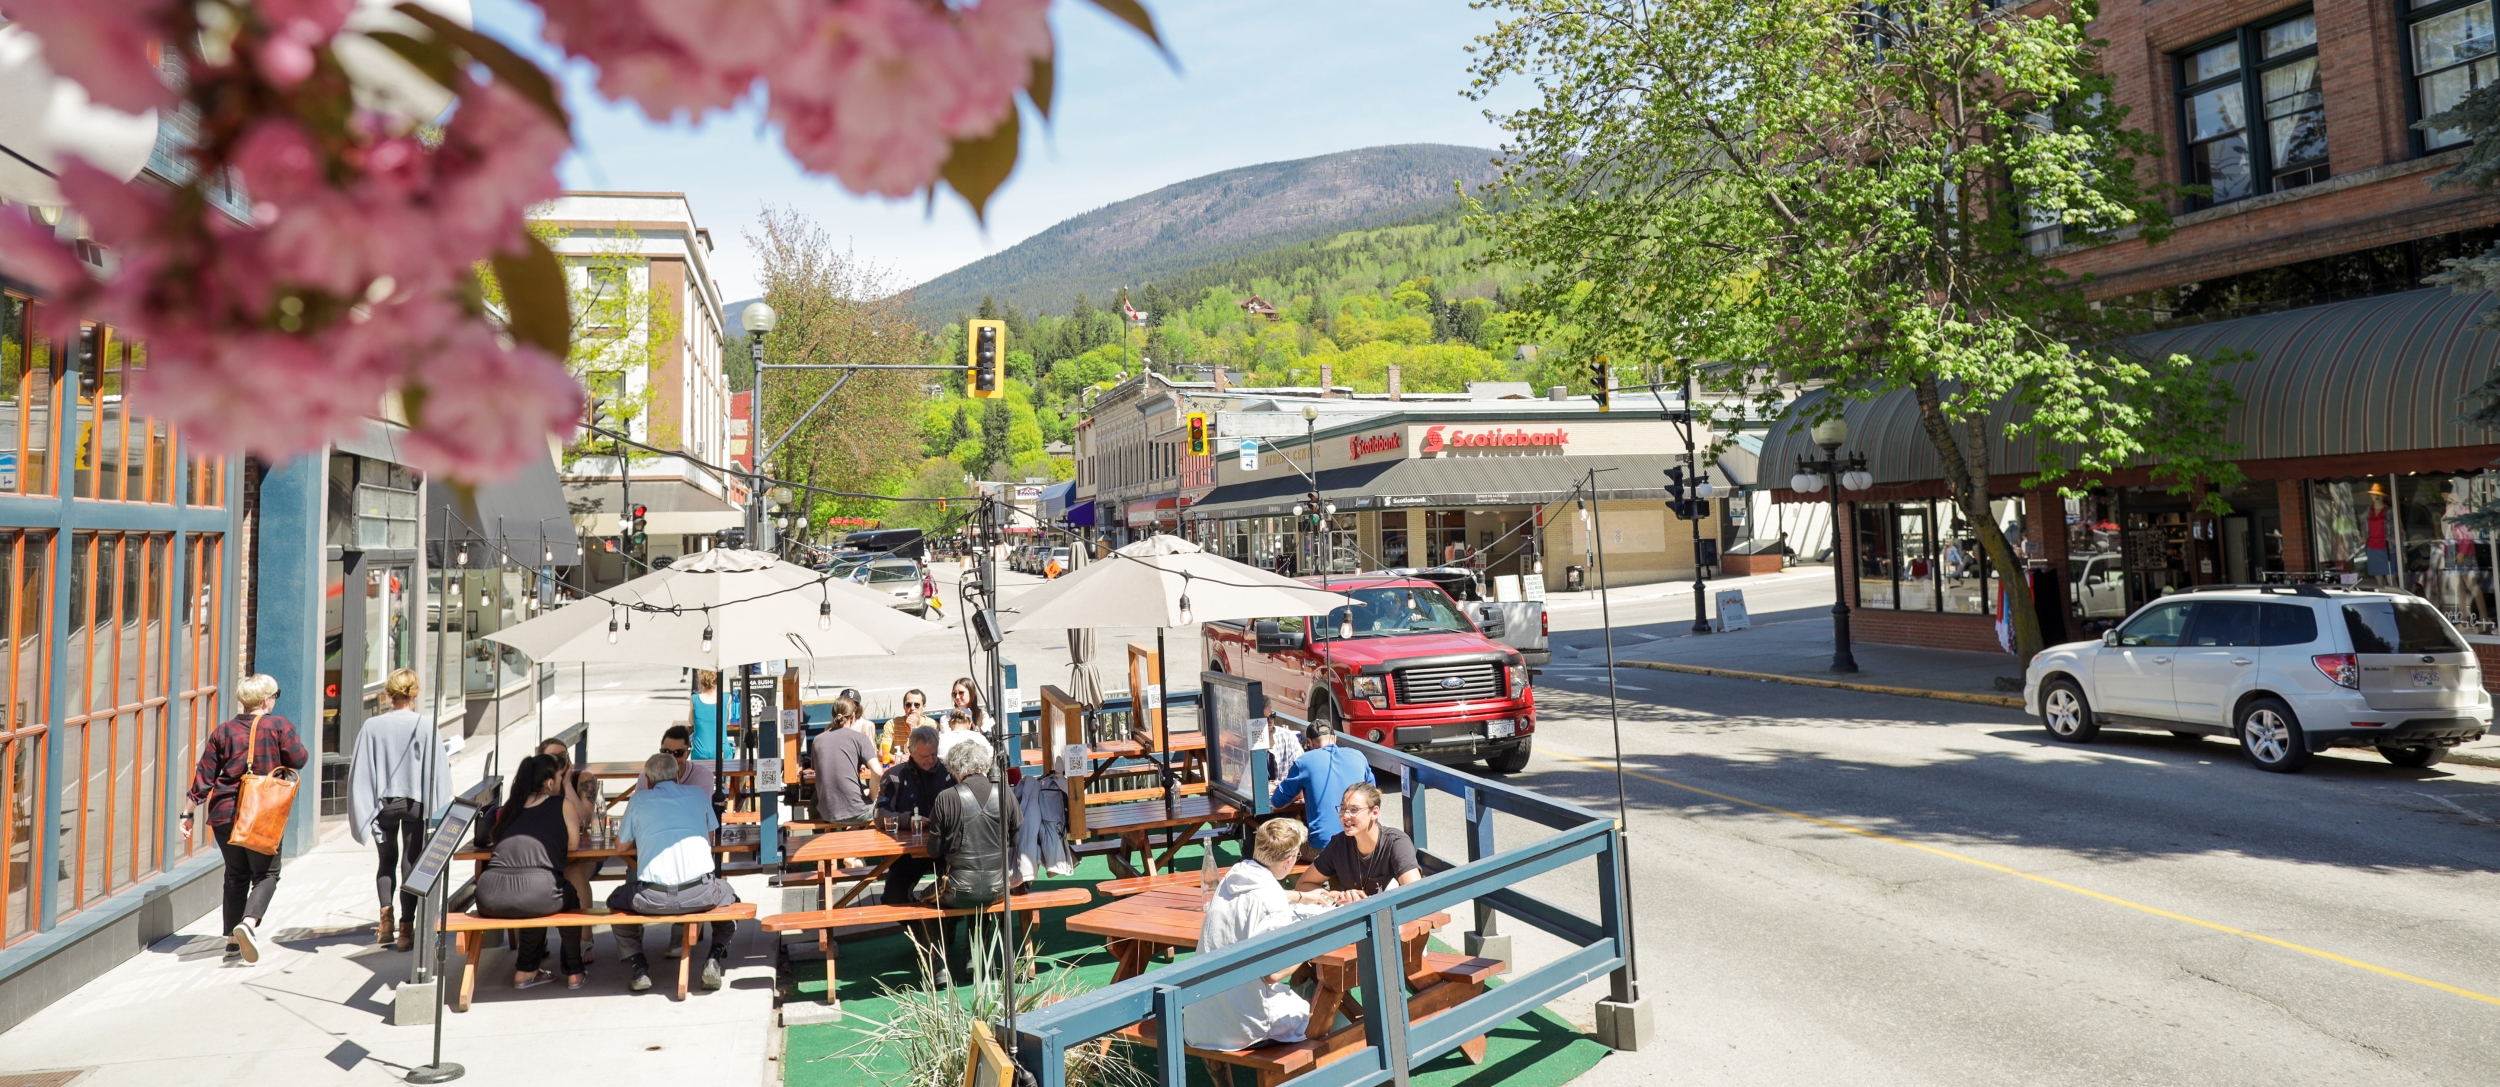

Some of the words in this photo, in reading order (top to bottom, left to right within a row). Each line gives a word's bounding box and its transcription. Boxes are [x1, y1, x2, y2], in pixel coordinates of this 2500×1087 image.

[1357, 432, 1400, 455] Scotiabank
[1452, 427, 1570, 448] Scotiabank
[1292, 445, 1321, 462] CENTE
[1393, 496, 1427, 504] Scotiabank
